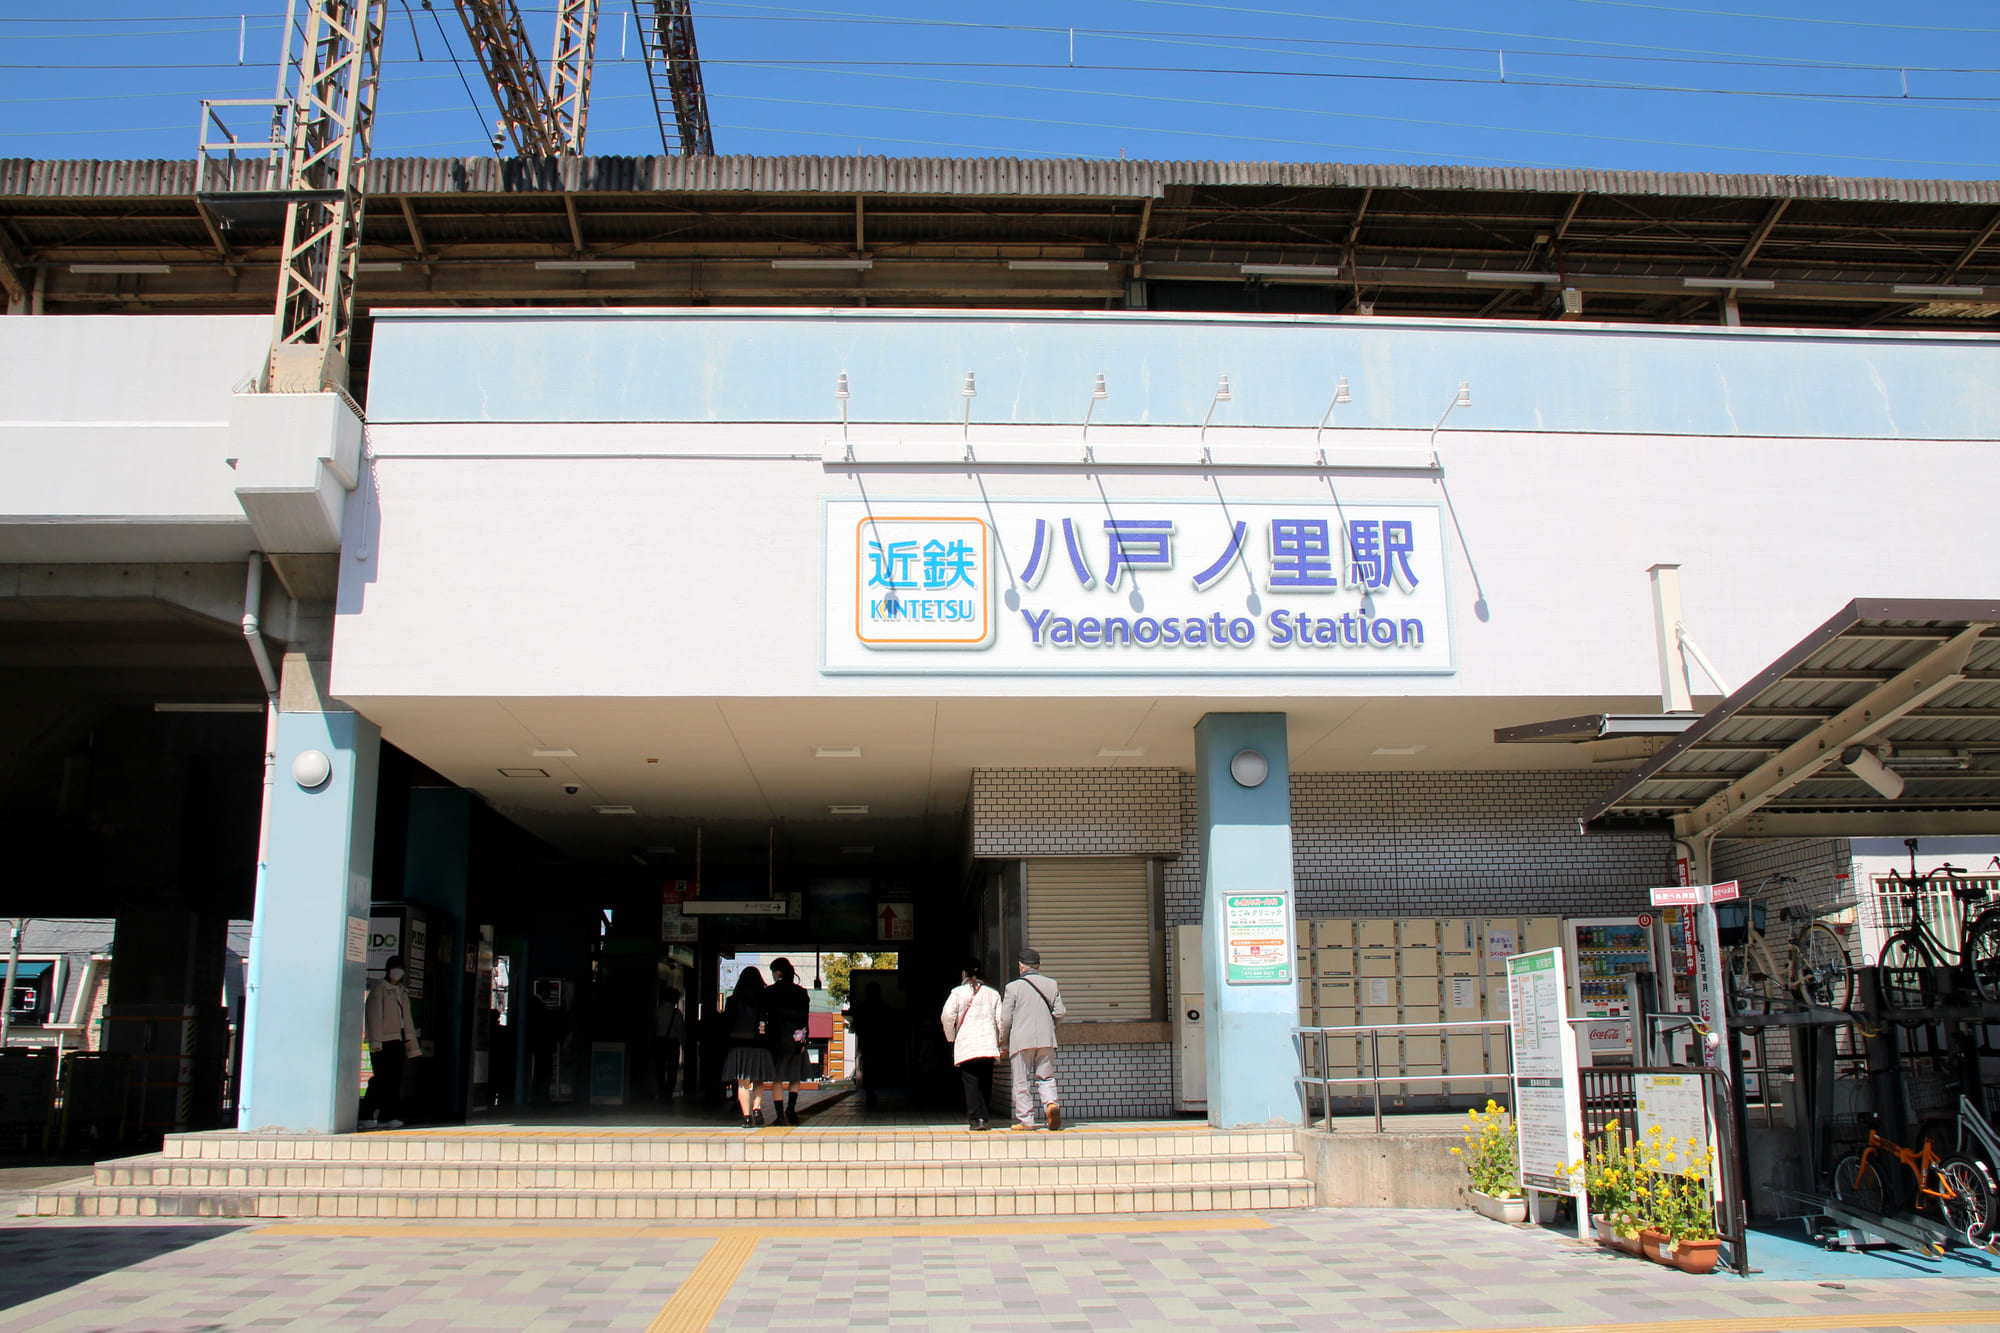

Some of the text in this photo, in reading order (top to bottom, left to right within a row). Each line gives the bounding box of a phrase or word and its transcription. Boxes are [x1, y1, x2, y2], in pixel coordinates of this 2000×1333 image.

[867, 538, 975, 589] 近鉄
[1019, 517, 1421, 589] 八戸ノ里駅
[870, 598, 973, 620] KINTETSU
[1020, 608, 1425, 644] Yaenosato Station
